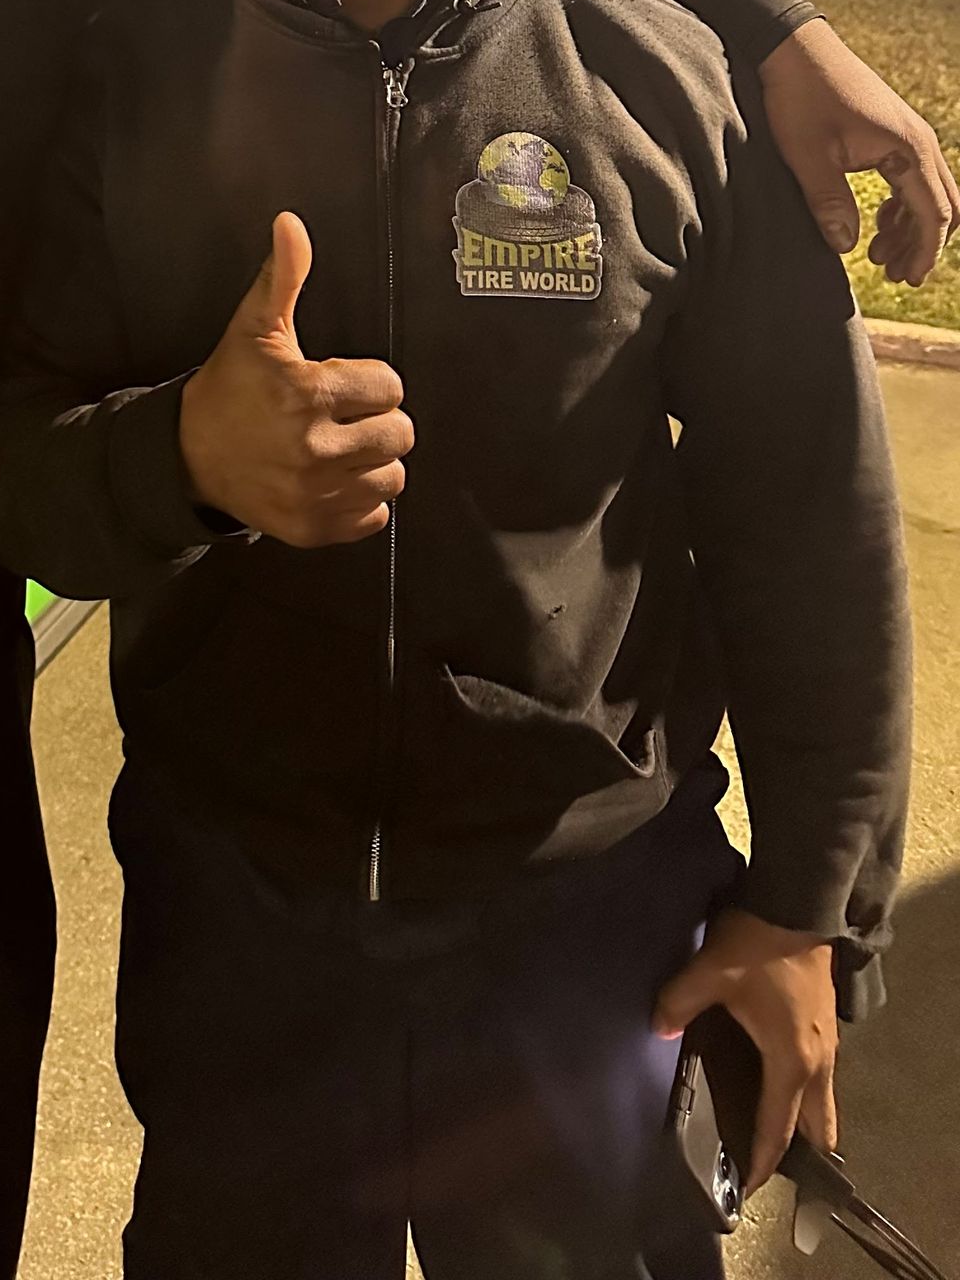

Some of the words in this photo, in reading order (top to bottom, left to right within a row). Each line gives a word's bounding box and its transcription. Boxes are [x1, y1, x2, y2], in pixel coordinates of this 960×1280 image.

[461, 227, 596, 271] EMPIRE
[463, 271, 514, 290] TIRE
[520, 271, 595, 293] WORLD
